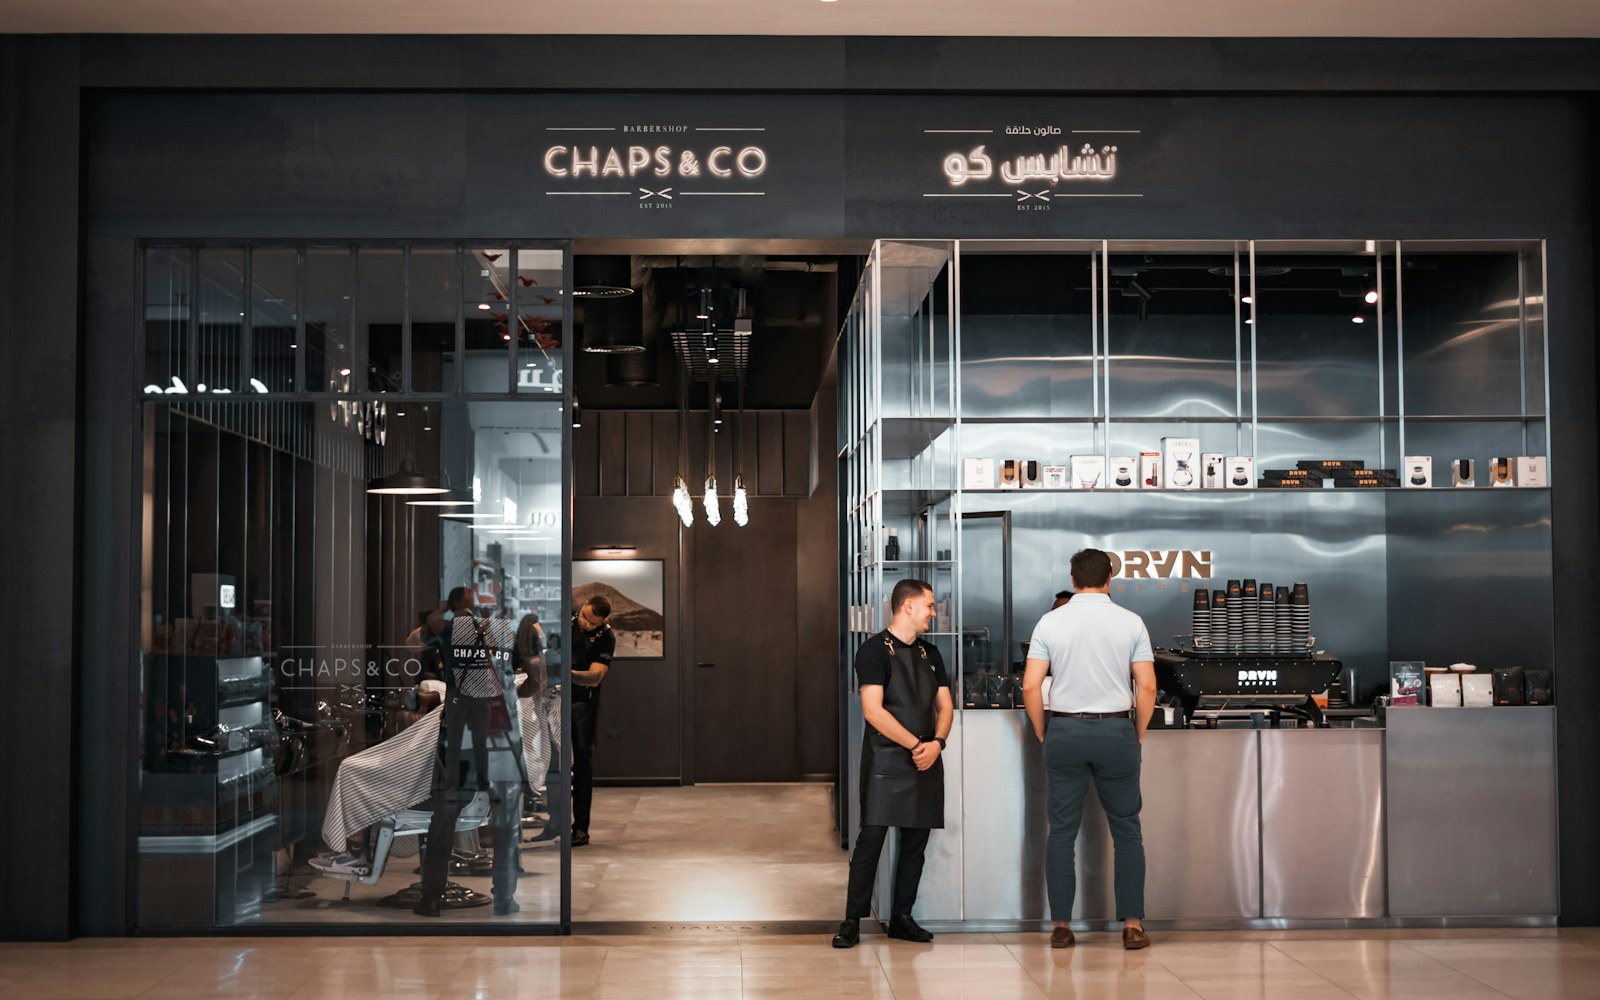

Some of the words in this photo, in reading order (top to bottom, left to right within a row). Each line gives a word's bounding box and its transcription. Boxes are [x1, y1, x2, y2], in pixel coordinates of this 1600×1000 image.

[623, 125, 689, 133] BARBERSHOP
[1005, 125, 1032, 136] حلاقة
[1033, 125, 1062, 137] صالون
[544, 145, 672, 177] CHAPS
[678, 149, 700, 176] &
[707, 145, 767, 177] CO
[944, 144, 993, 185] كو
[1001, 143, 1118, 184] تشابس
[495, 650, 510, 661] CO
[280, 658, 361, 677] CHAPS
[366, 660, 380, 677] &
[385, 658, 422, 677] CO
[1238, 670, 1277, 681] DRVN
